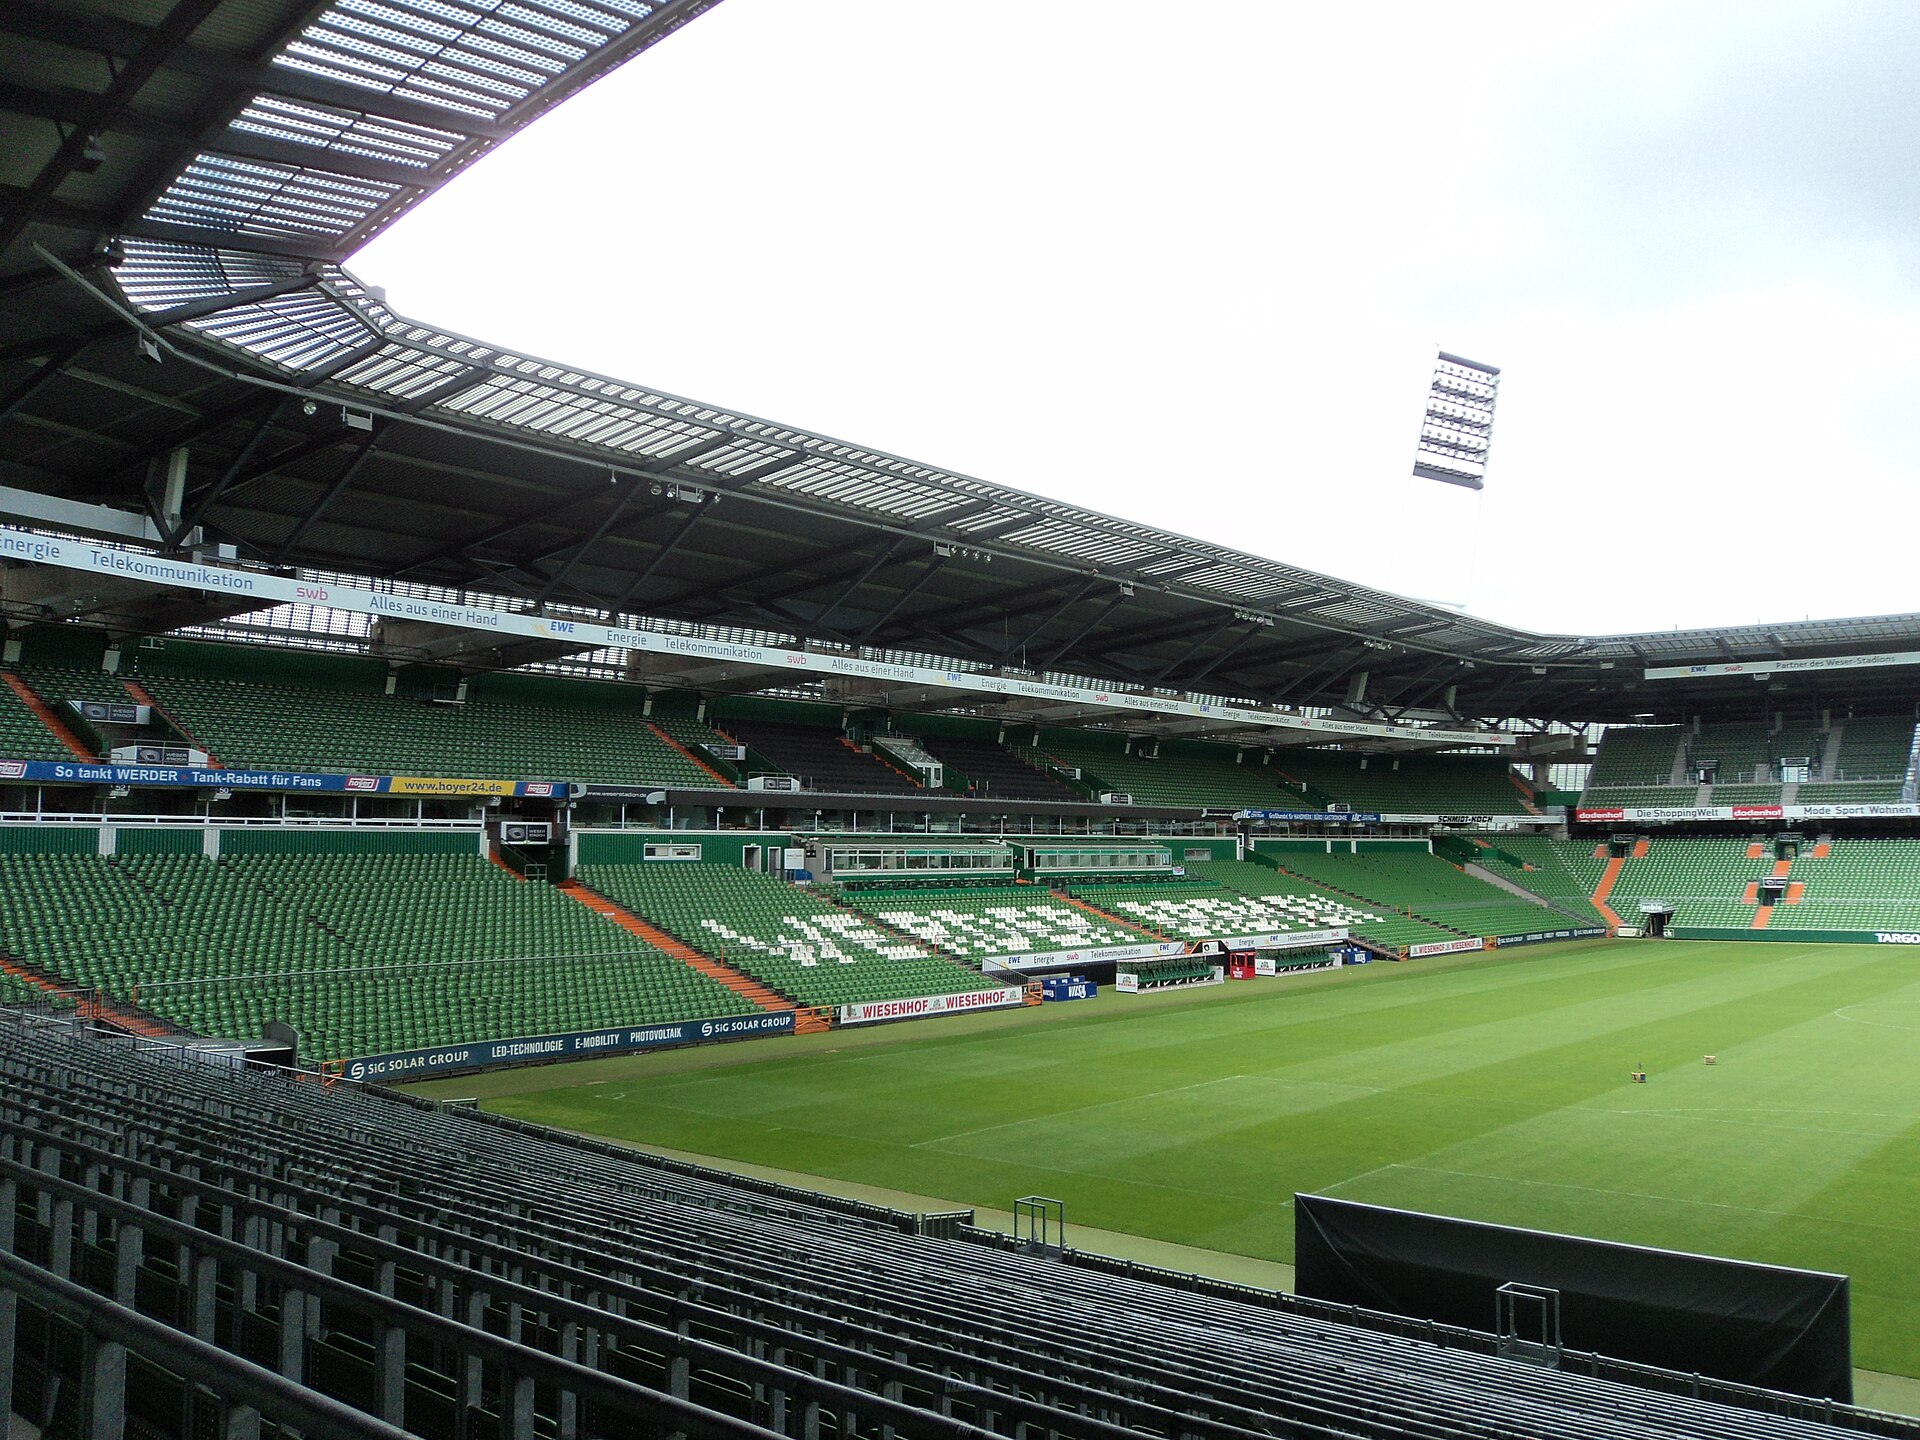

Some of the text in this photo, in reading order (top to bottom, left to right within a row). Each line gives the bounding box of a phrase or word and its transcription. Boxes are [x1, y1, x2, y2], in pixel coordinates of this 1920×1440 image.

[0, 533, 253, 590] nergie Telekommunikation
[296, 586, 329, 601] swb
[369, 596, 498, 626] Alles aus einer Hand
[550, 621, 575, 633] EWE
[607, 630, 762, 660] Energie Telekommunikation
[786, 654, 807, 665] swb
[1690, 665, 1707, 673] EWE
[1724, 665, 1743, 673] swb
[1776, 661, 1807, 670] Partner
[1825, 655, 1896, 666] Weser-Stadions
[831, 659, 914, 679] Alles aus einer Hand
[946, 673, 962, 682] EWE
[981, 678, 1080, 699] Energie Telekommunikation
[1095, 693, 1109, 703] swb
[1124, 697, 1179, 711] Alles aus einer Hand
[1199, 705, 1210, 713] EWE
[1222, 709, 1290, 725] Energie Telekommunikation
[55, 765, 322, 787] So tankt WERDER Tank-Rabatt für Fans
[404, 781, 502, 795] www.hoyer24.de
[1578, 808, 1719, 819] dodenhof Die ShoppingWelt
[1733, 808, 1781, 816] dodenhof
[1803, 807, 1831, 815] Mode
[1835, 806, 1864, 815] Sport
[1869, 805, 1912, 814] Wohnen
[1238, 938, 1254, 947] Energie
[1875, 933, 1920, 943] TARGO
[1008, 956, 1021, 964] EWE
[1033, 955, 1055, 965] Energie
[1066, 952, 1080, 961] swb
[1090, 947, 1142, 959] Telekommunikation
[862, 991, 1006, 1019] WIESENHOF WIESENHOF
[389, 1058, 425, 1071] SOLAR
[428, 1051, 469, 1065] GROUP
[491, 1039, 564, 1058] LED-TECHNOLOGIE
[575, 1034, 620, 1049] E-MOBILITY
[630, 1027, 682, 1043] PHOTOVOLTAIK
[731, 1019, 759, 1031] SOLAR
[761, 1016, 791, 1028] GROUP
